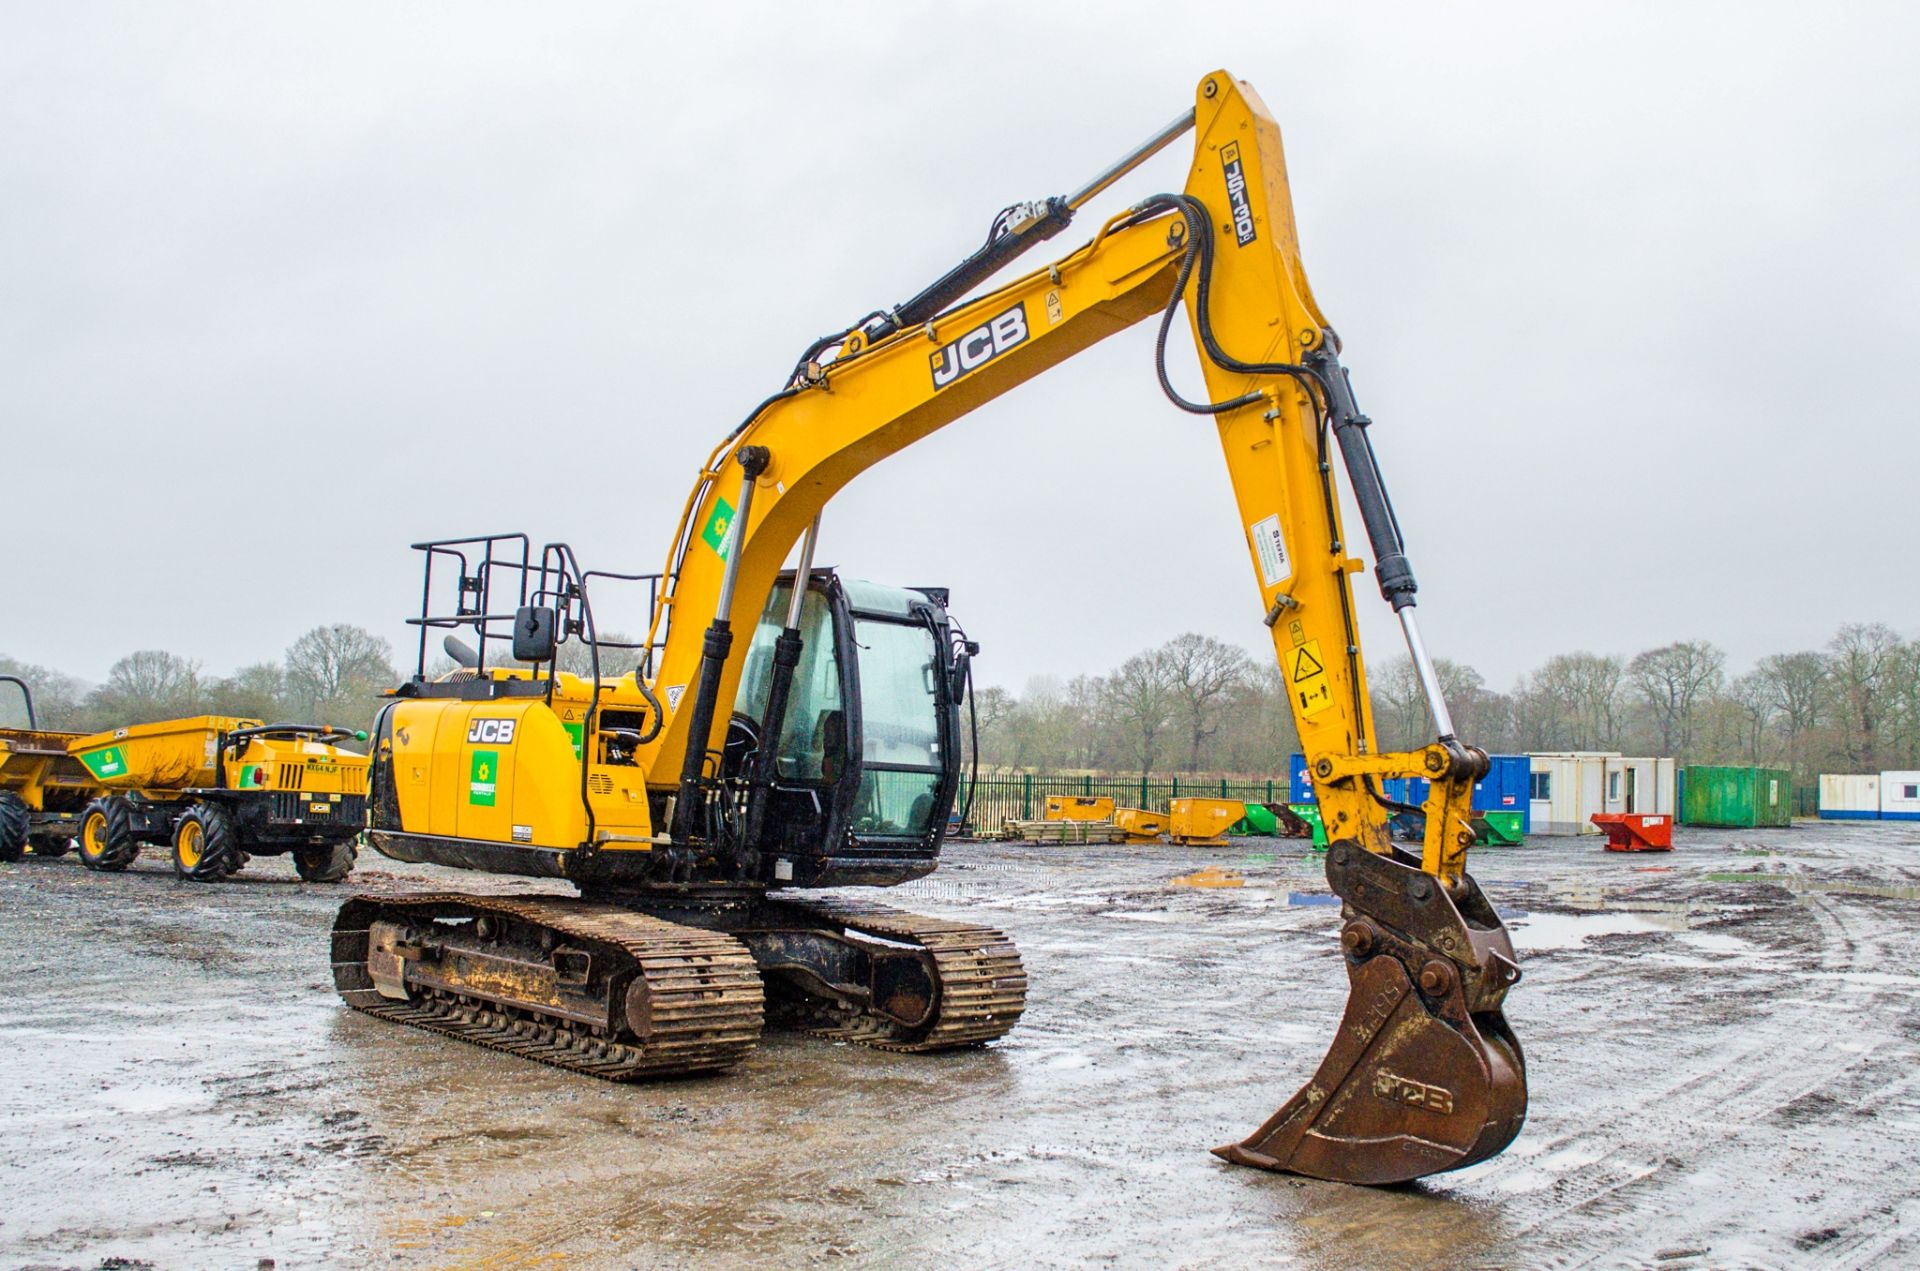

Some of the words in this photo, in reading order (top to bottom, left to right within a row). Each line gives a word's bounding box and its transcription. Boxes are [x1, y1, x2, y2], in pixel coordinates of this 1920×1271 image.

[1226, 160, 1253, 237] JS130
[934, 307, 1027, 386] JCB
[468, 719, 515, 742] JCB
